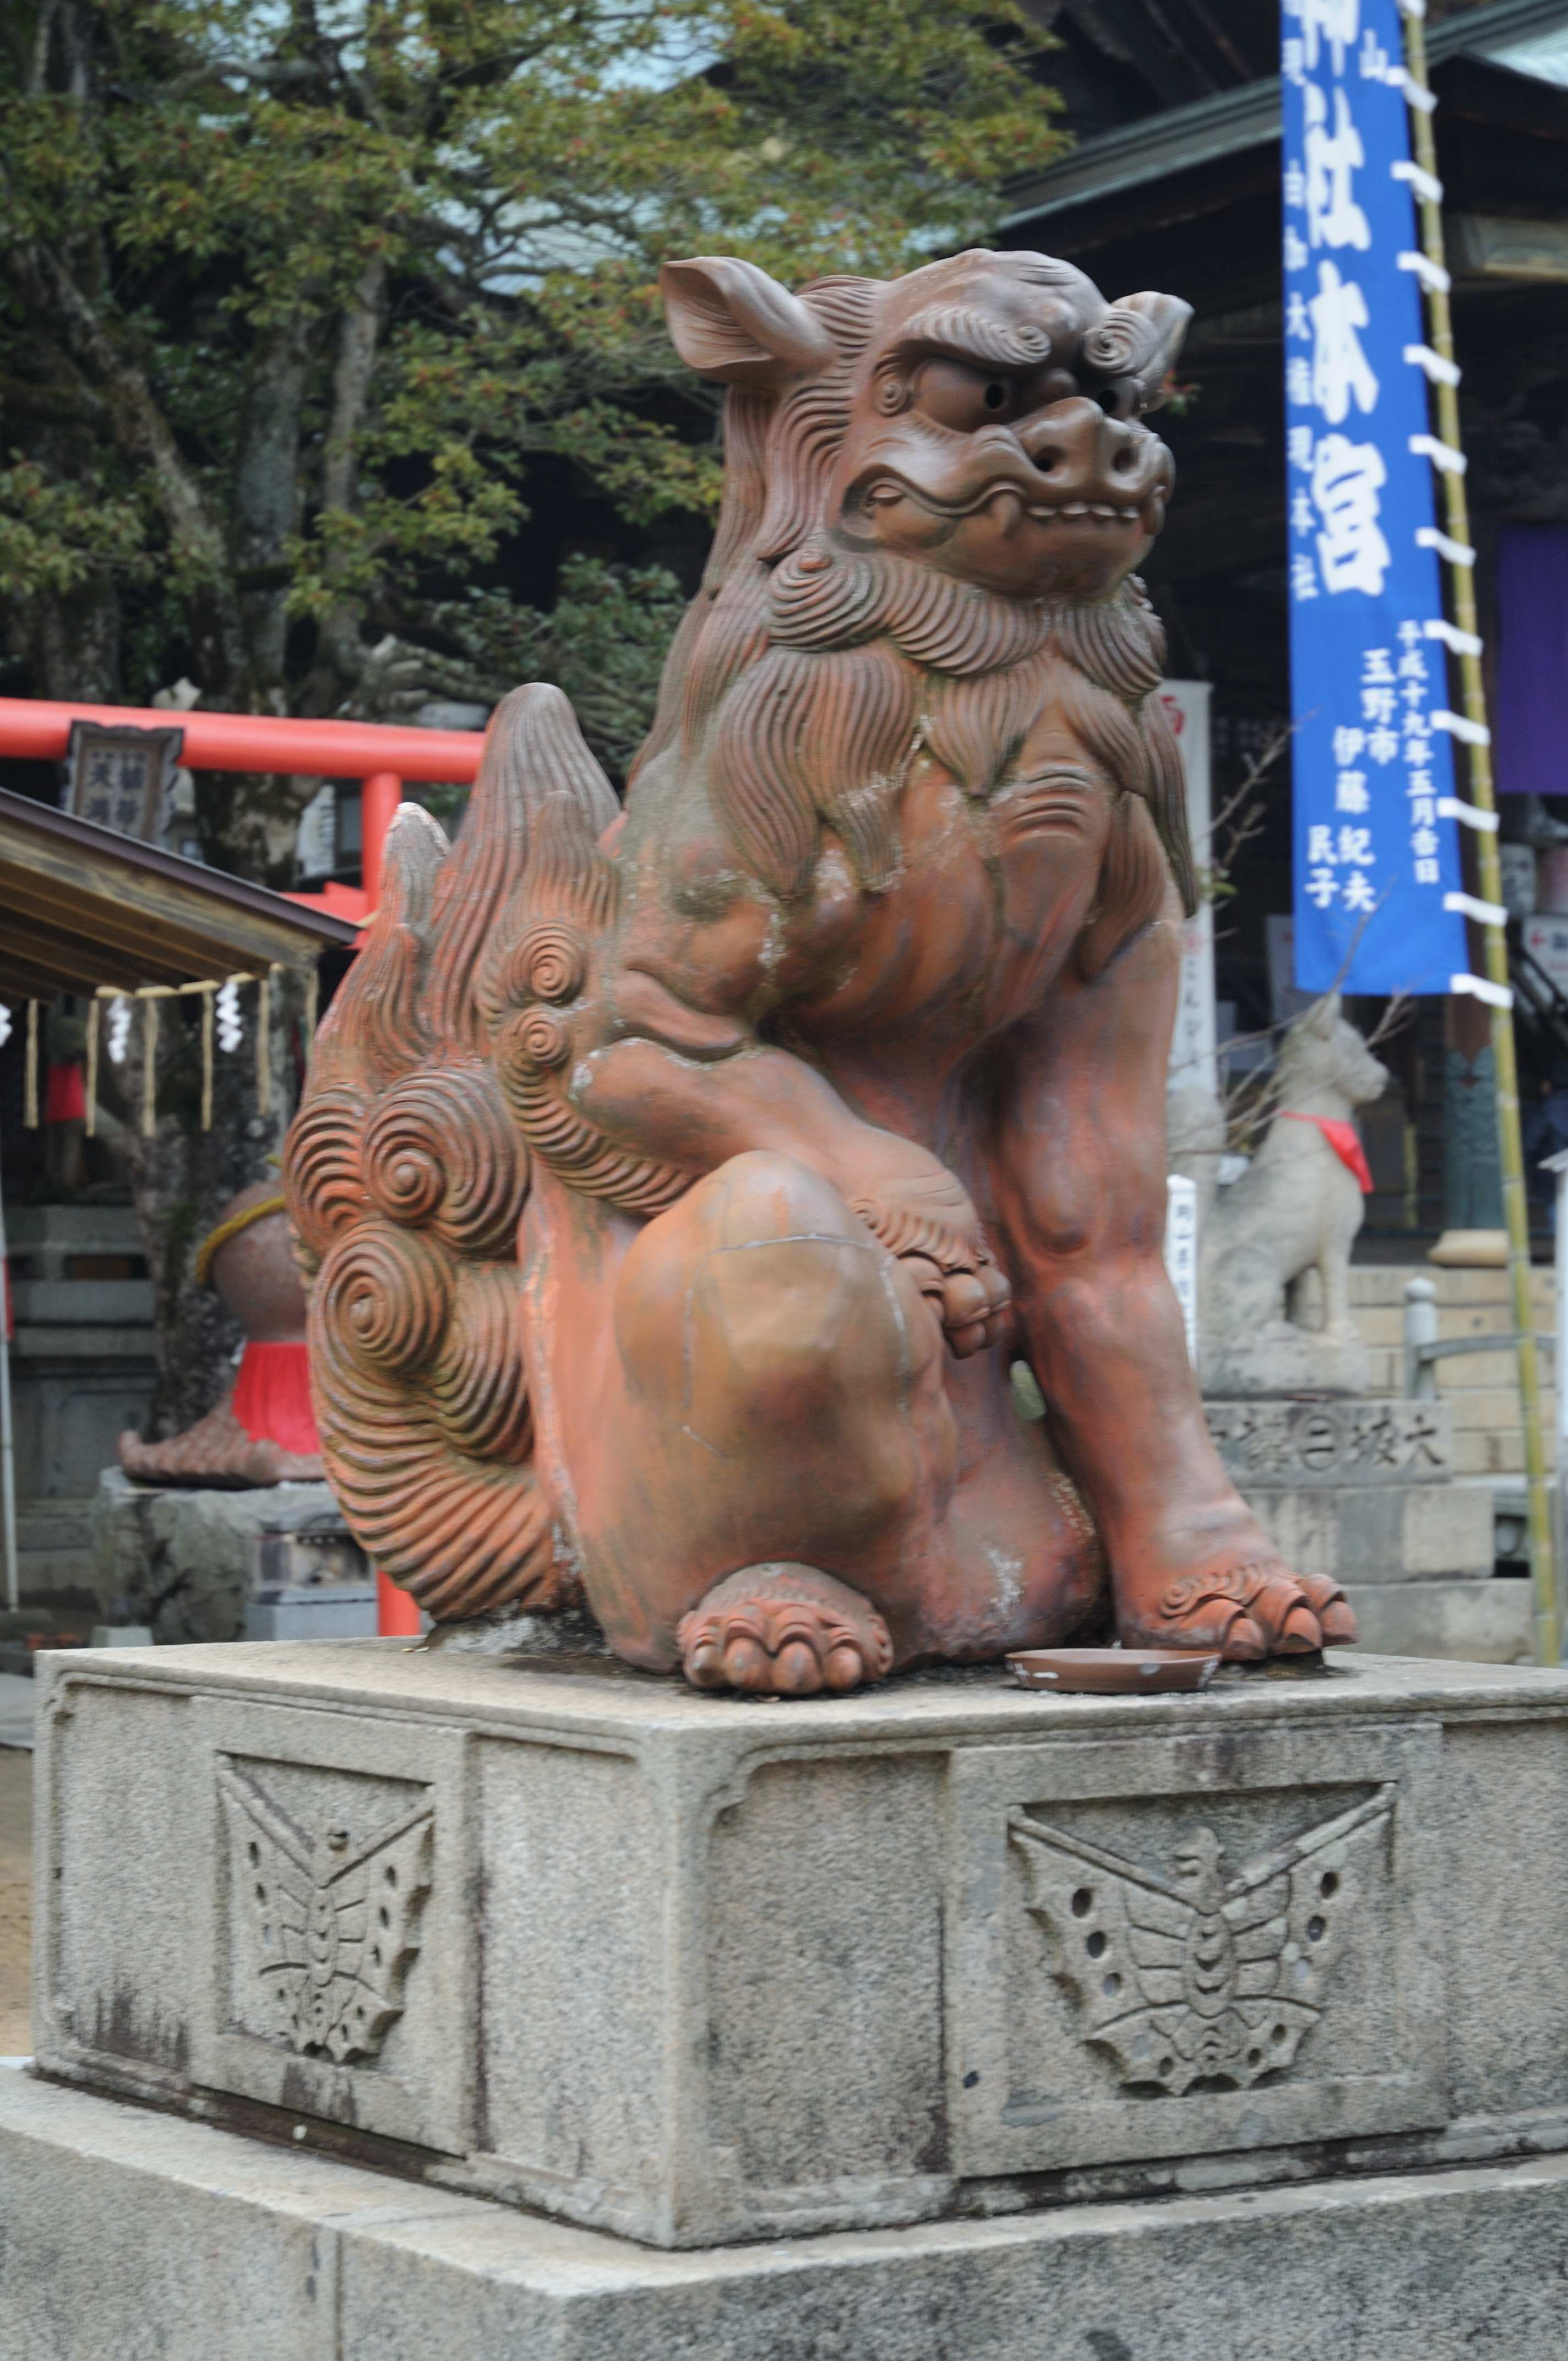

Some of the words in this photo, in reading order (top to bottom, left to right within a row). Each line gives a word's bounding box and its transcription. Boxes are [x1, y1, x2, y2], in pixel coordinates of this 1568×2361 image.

[1360, 648, 1400, 766] 玉野市
[1396, 619, 1440, 884] 平成十九年五月吉日
[1304, 824, 1340, 909] 民子
